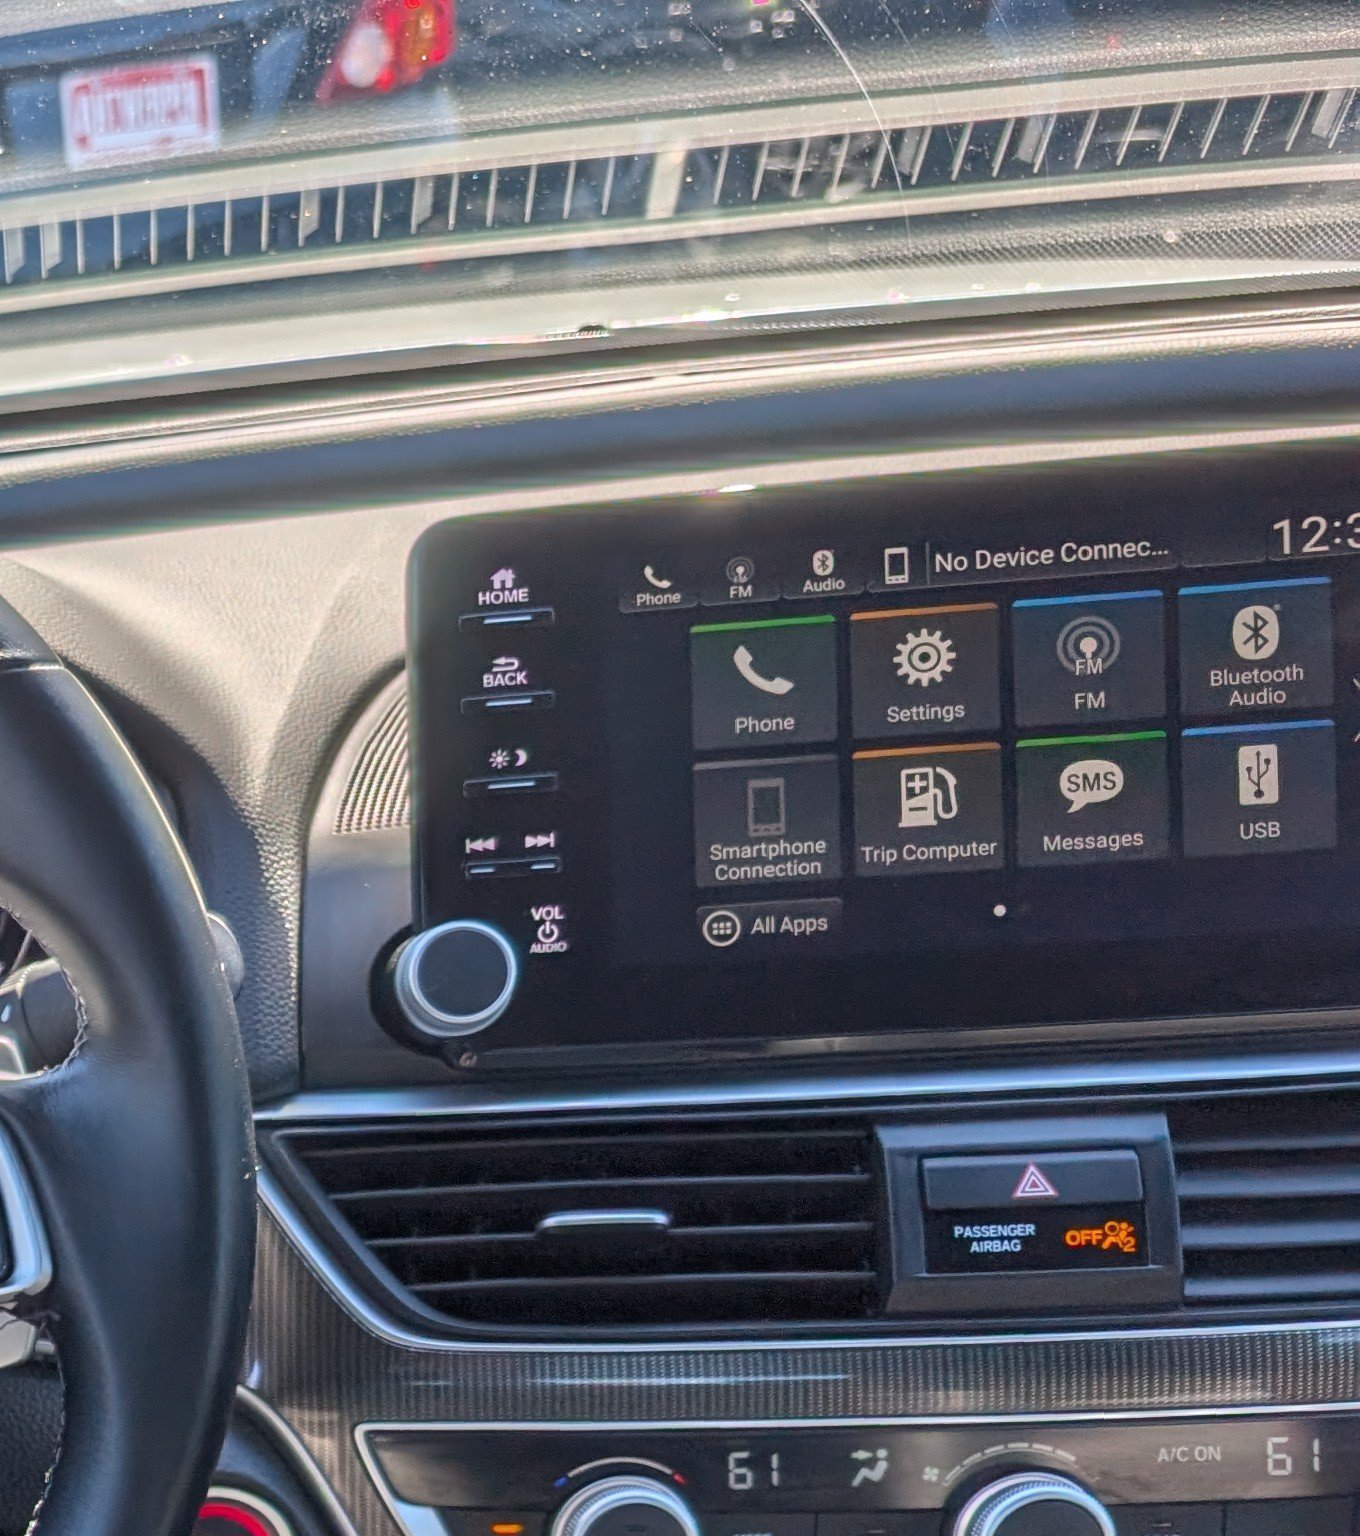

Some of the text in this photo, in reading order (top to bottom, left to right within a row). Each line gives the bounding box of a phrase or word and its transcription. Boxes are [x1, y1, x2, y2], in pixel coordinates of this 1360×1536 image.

[935, 551, 969, 574] No
[975, 545, 1055, 570] Device
[730, 585, 753, 599] FM
[803, 577, 846, 594] Audio
[478, 588, 529, 606] HOME
[636, 588, 681, 607] Phone
[1074, 658, 1104, 676] FM
[1210, 664, 1304, 687] Bluetooth
[483, 670, 529, 688] BACK
[1074, 691, 1106, 710] FM
[1229, 688, 1287, 706] Audio
[887, 701, 966, 725] Settings
[735, 713, 796, 735] Phone
[1066, 770, 1117, 793] SMS
[1239, 821, 1281, 841] USB
[709, 837, 826, 864] Smartphone
[860, 838, 998, 867] Trip Computer
[1043, 831, 1144, 855] Messages
[714, 858, 822, 882] Connection
[530, 906, 565, 920] VOL
[751, 913, 828, 937] All Apps
[529, 941, 568, 954] AUDIO
[954, 1223, 1036, 1239] PASSENGER
[1064, 1229, 1102, 1247] OFF
[970, 1239, 1021, 1254] AIRBAG
[1157, 1445, 1221, 1463] A/C ON
[1266, 1436, 1321, 1476] 61
[729, 1451, 779, 1490] 61
